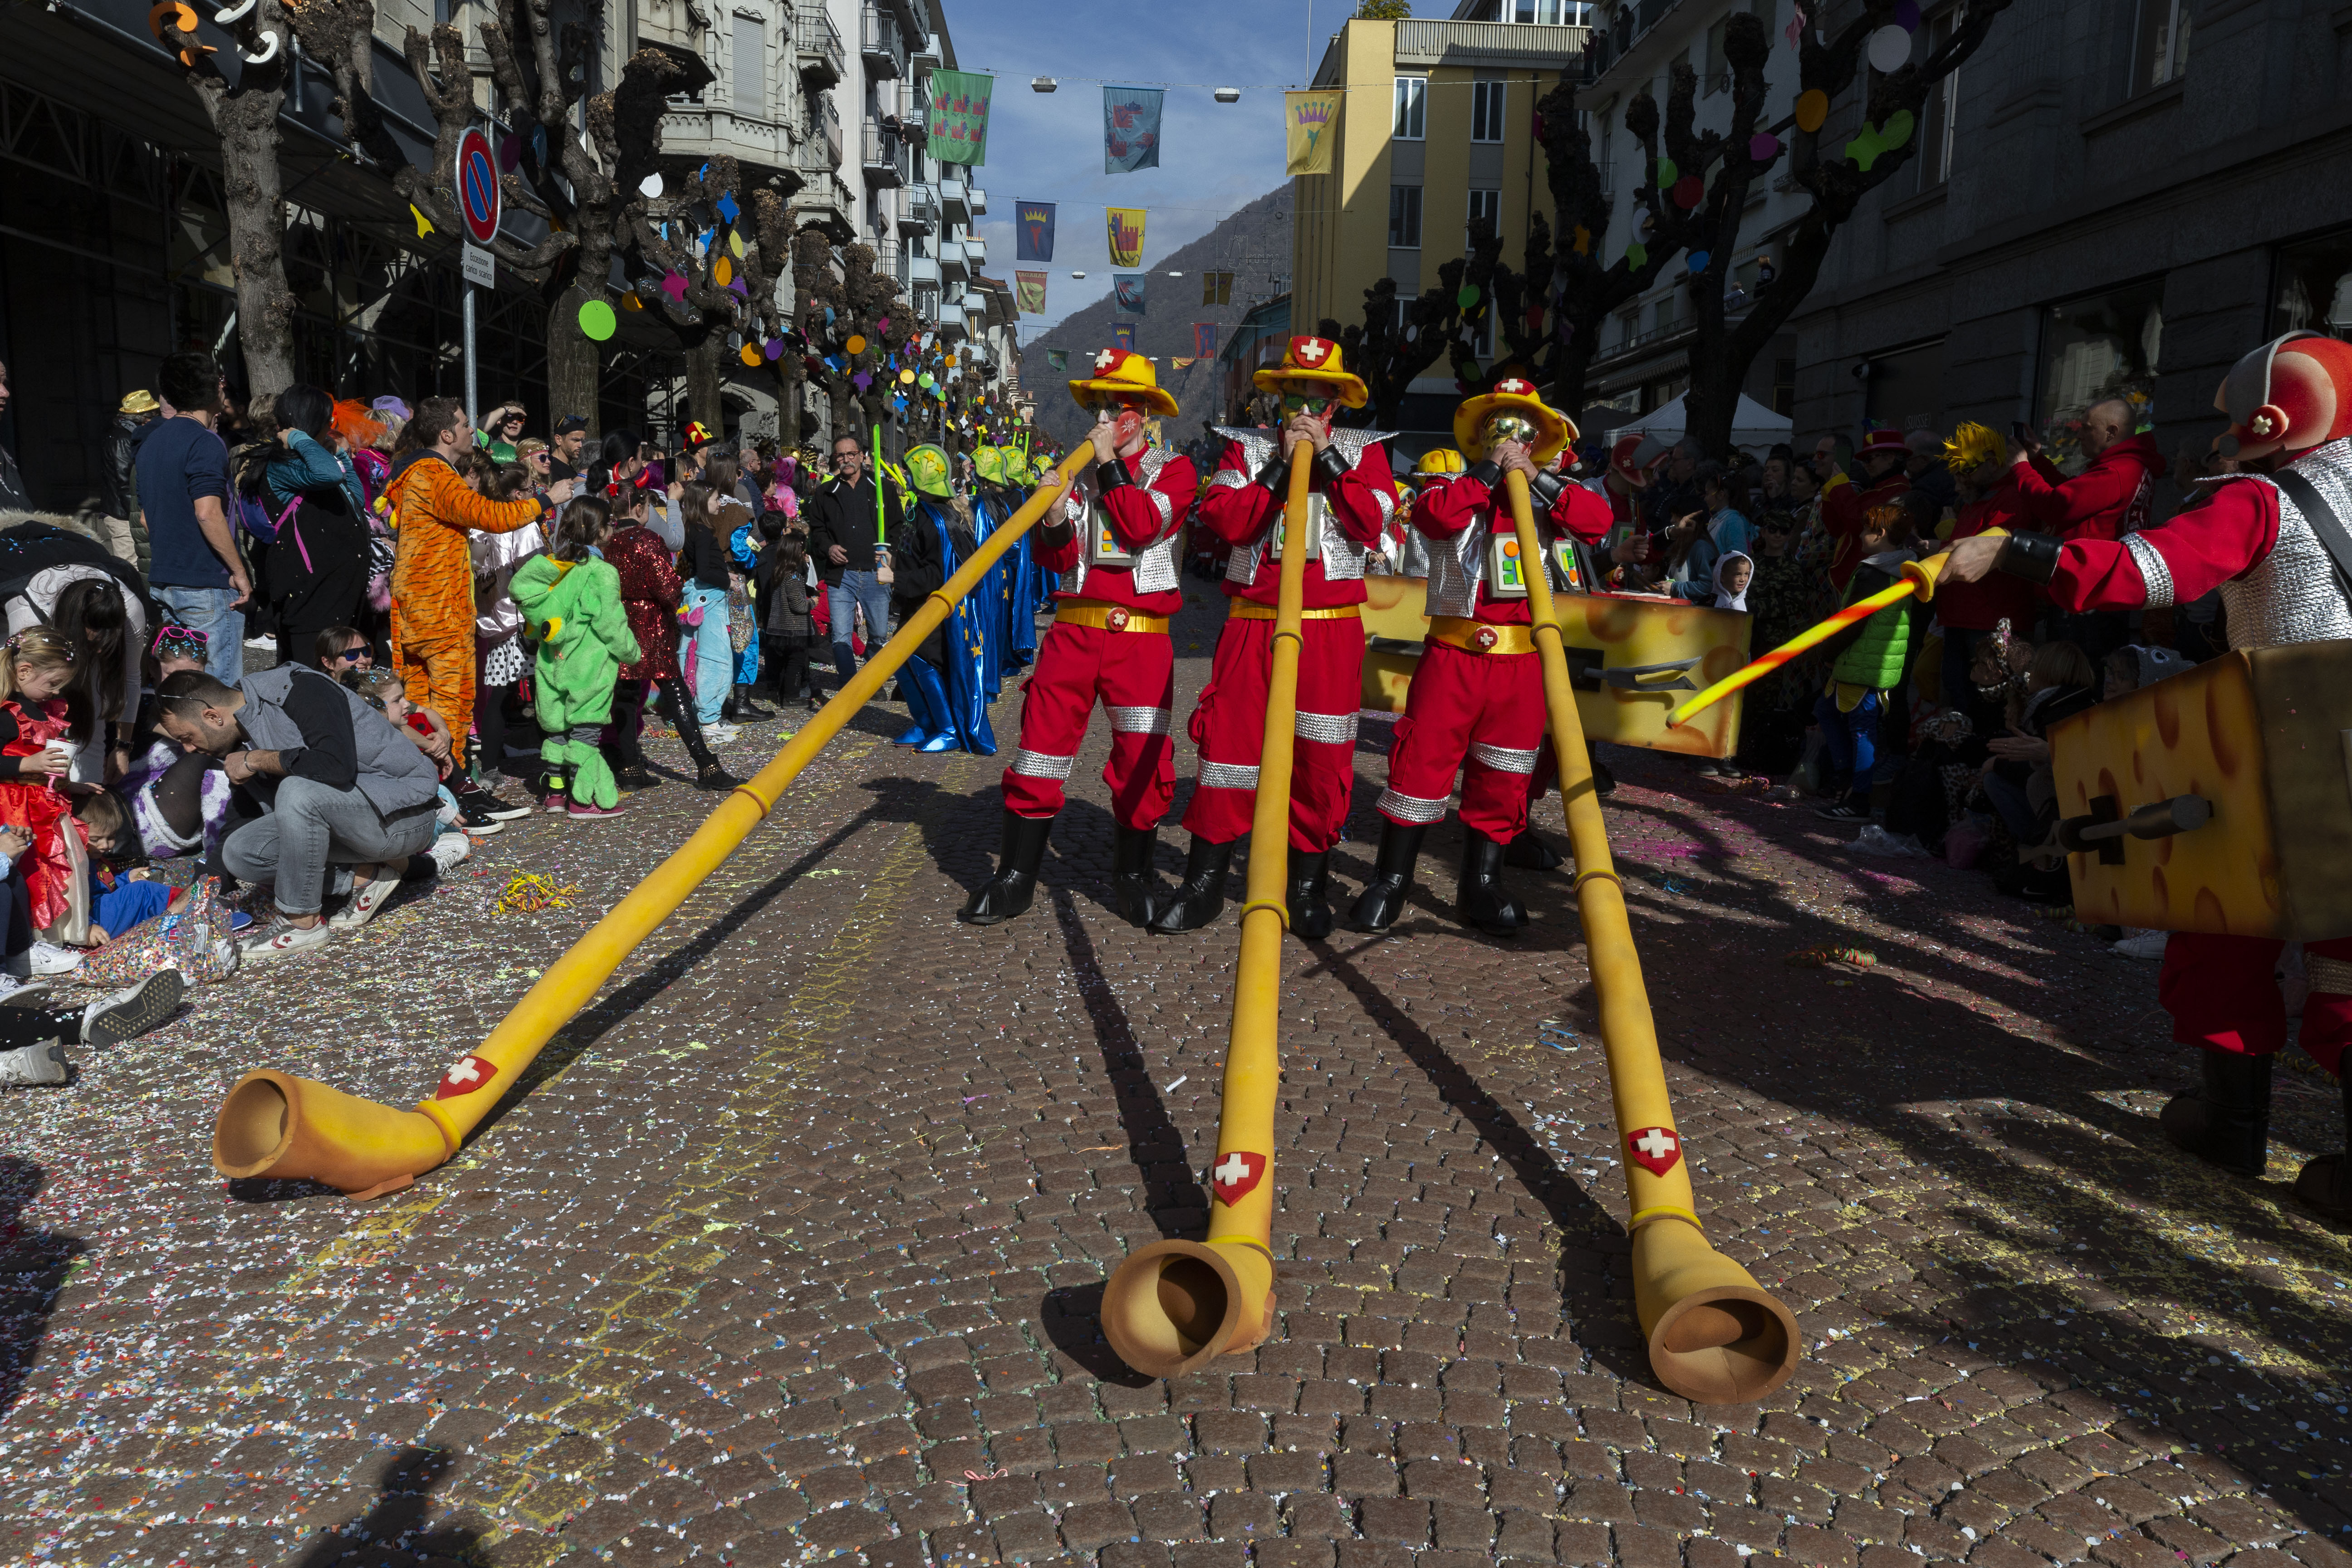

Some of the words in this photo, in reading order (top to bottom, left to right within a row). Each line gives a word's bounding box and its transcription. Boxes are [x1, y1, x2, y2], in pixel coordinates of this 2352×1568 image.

[470, 252, 489, 268] Eccezione
[466, 265, 478, 275] carico
[479, 270, 492, 281] scarico
[1905, 411, 1931, 431] (SUISSE)
